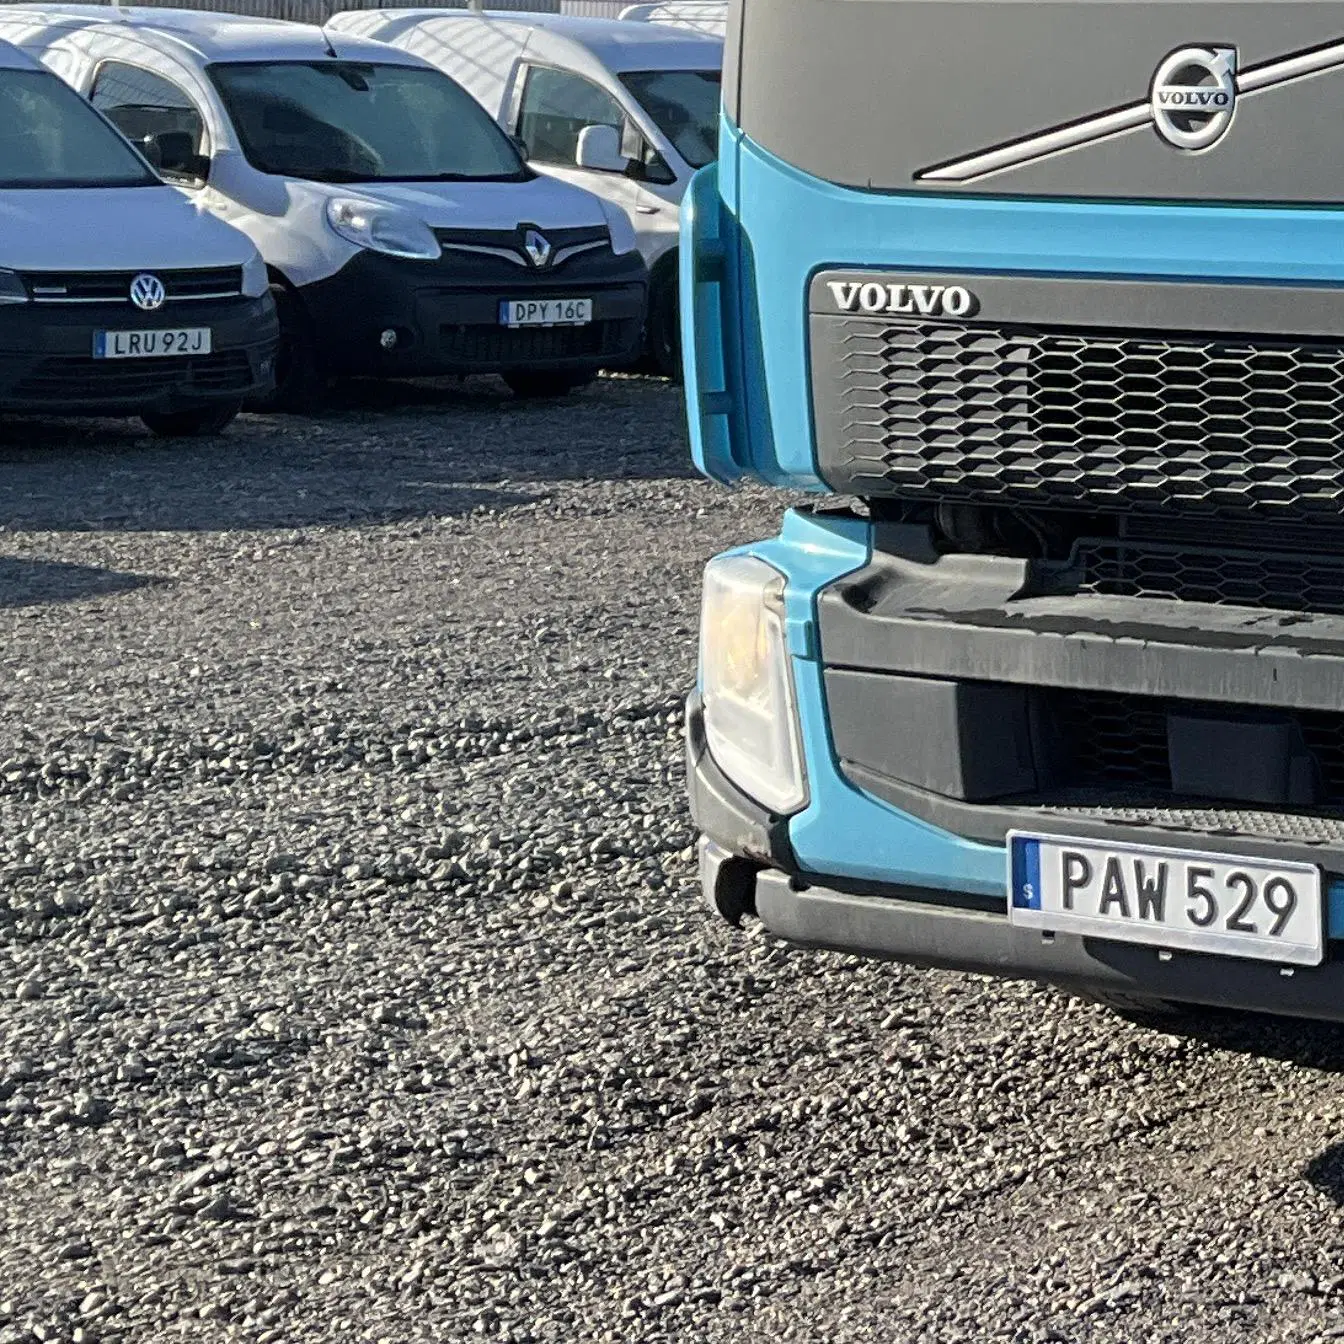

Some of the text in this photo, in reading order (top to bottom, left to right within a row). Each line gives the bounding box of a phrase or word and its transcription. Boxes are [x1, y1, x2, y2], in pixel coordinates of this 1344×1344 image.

[1158, 91, 1229, 106] VOLVO
[827, 281, 971, 316] VOLVO
[515, 301, 585, 321] DPY 16C
[114, 332, 202, 355] LRU 92J
[1061, 850, 1299, 937] PAW 529
